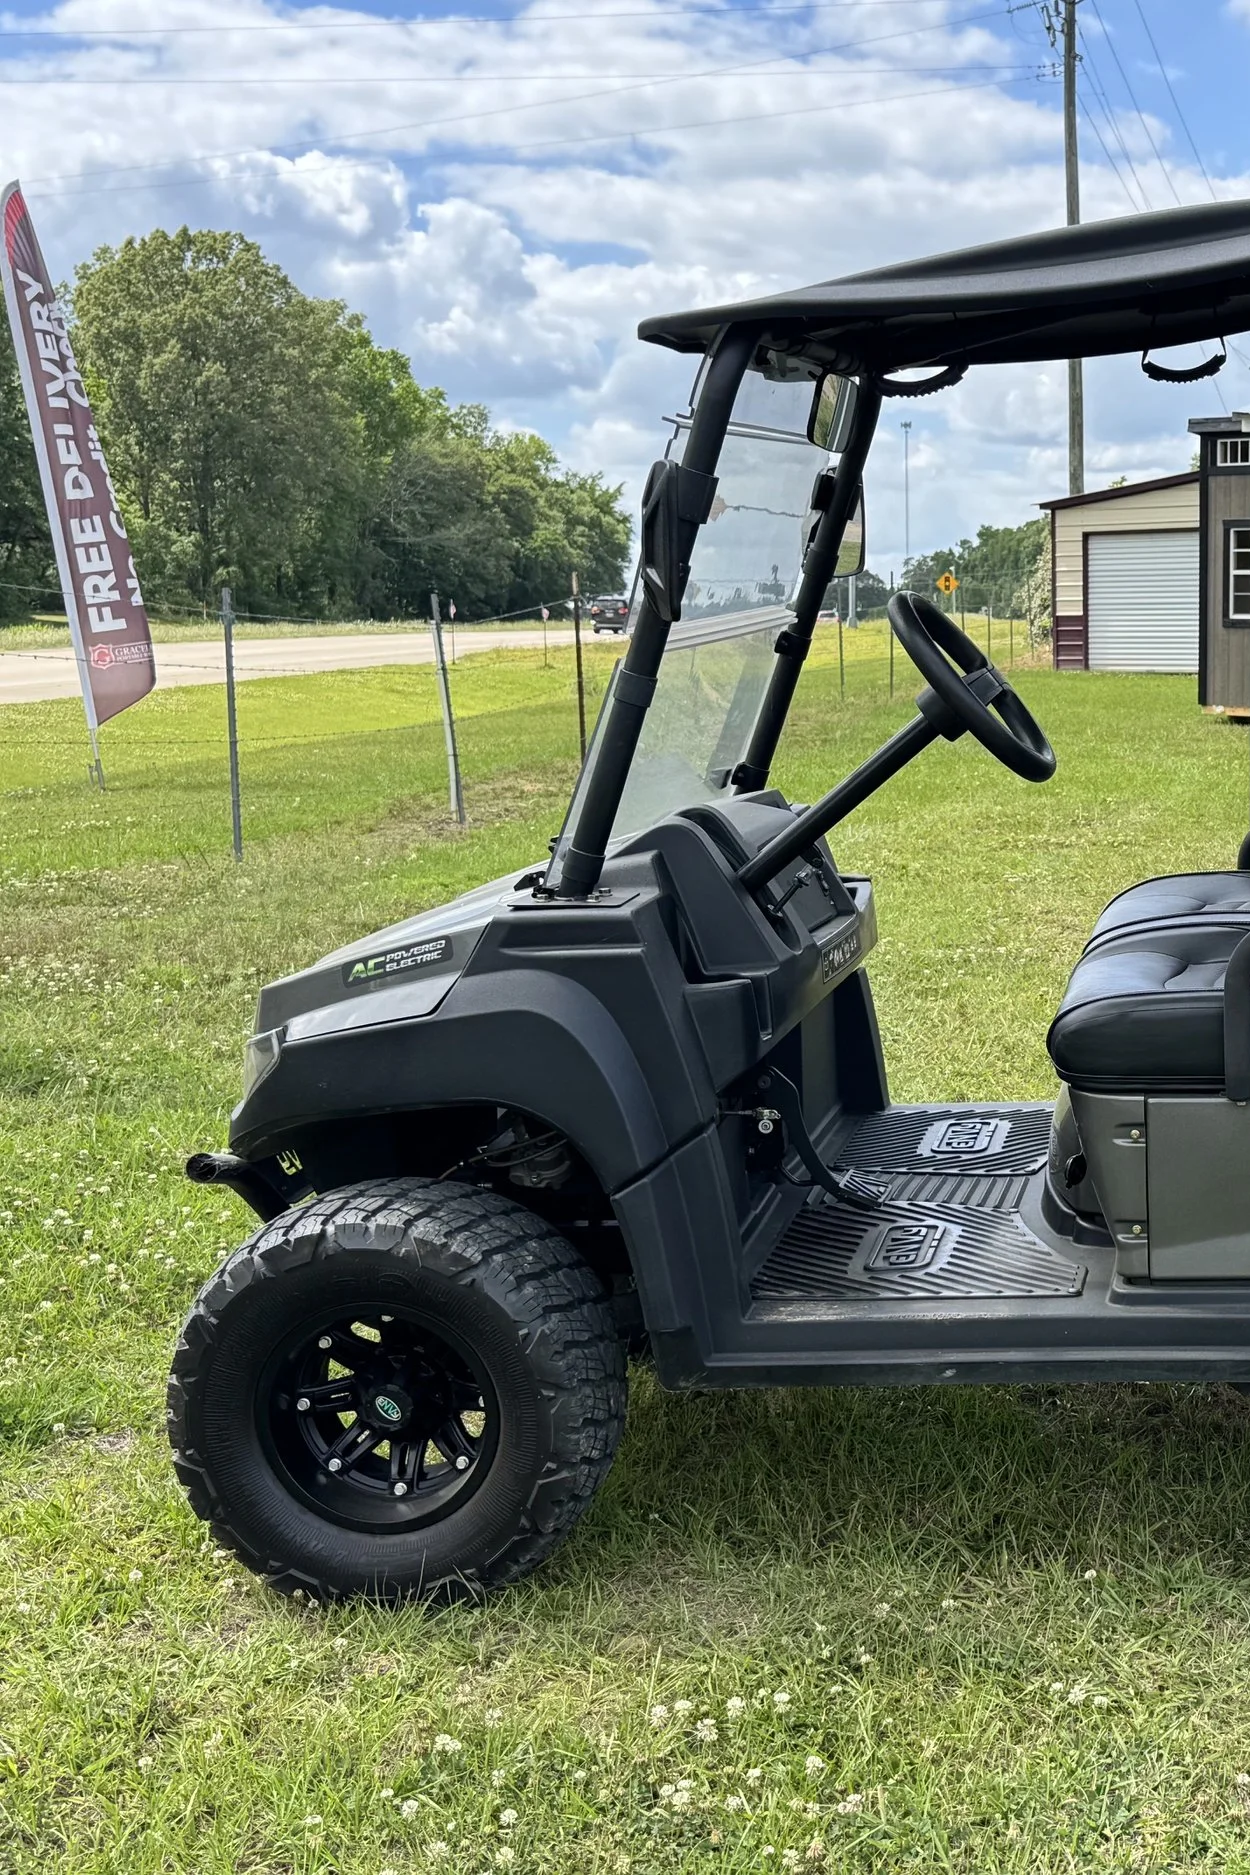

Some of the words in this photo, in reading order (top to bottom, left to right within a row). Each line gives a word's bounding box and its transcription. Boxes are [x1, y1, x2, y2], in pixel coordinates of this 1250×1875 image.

[86, 423, 128, 540] Cdit
[69, 514, 128, 634] FREE
[385, 939, 446, 963] POWERED
[385, 950, 443, 973] ELECTRIC
[347, 955, 386, 983] AC
